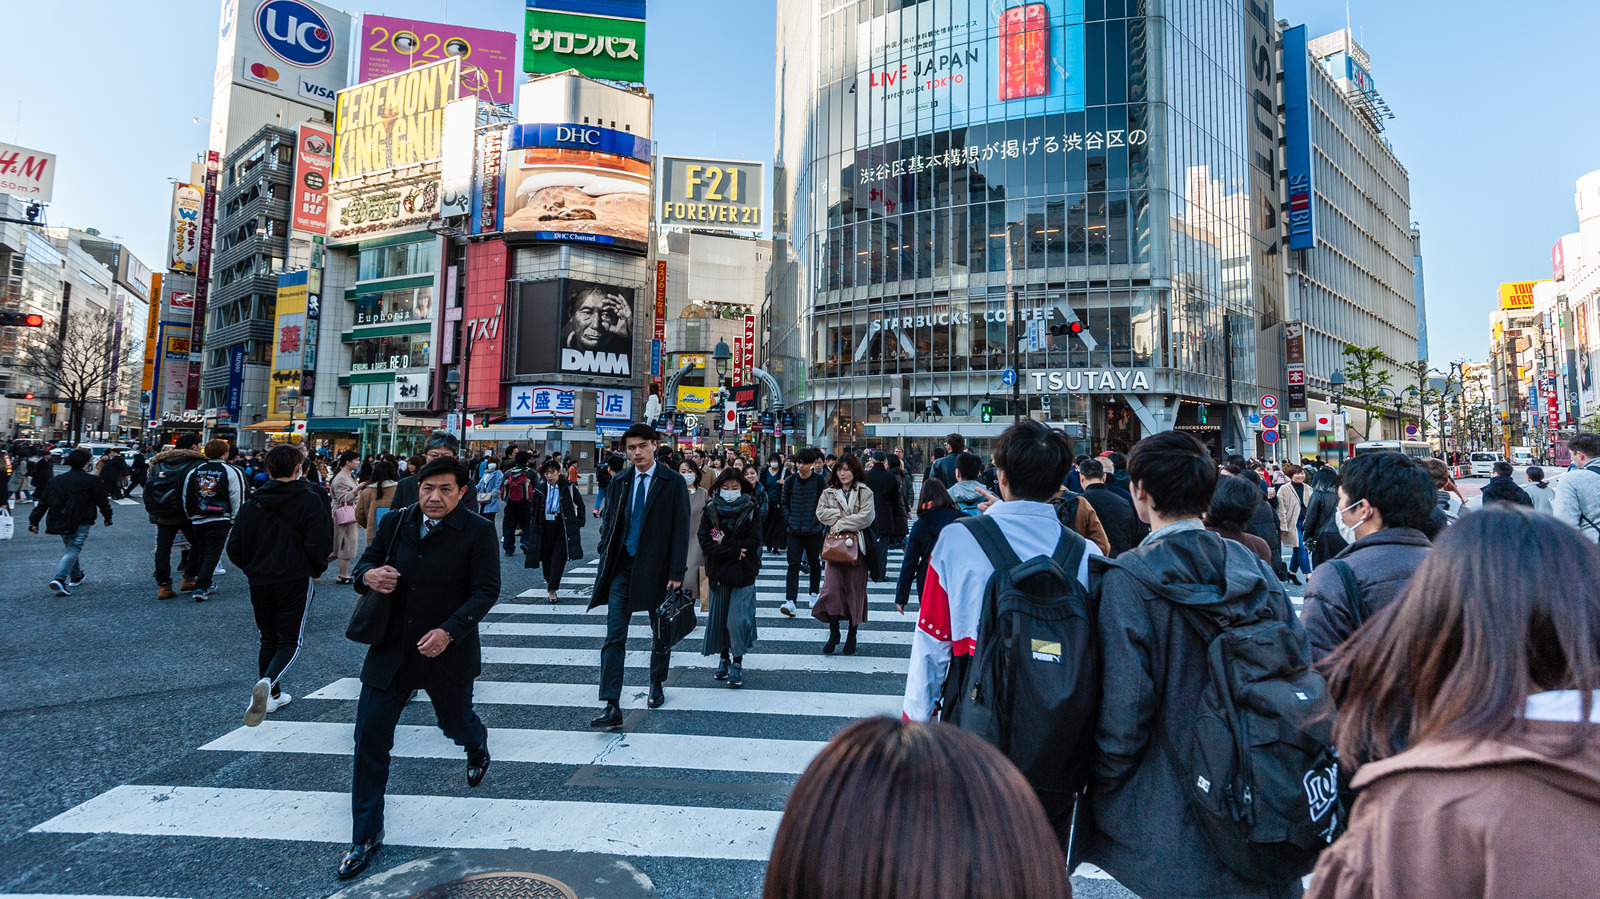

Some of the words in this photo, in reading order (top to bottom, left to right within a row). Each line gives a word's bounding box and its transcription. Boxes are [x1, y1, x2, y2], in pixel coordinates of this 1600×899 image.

[265, 8, 327, 54] UC
[369, 27, 471, 60] 2020
[529, 29, 638, 61] サロンパス
[871, 64, 907, 87] LIVE
[913, 48, 978, 77] JAPAN
[302, 81, 335, 101] VISA
[926, 74, 963, 90] TOKYO
[337, 60, 456, 135] CEREMONY
[333, 122, 387, 179] KING
[391, 107, 444, 167] GNU
[555, 127, 600, 145] DHC
[0, 150, 48, 182] H&M
[859, 128, 1148, 185] 渋谷区基本構想が掲げる渋谷区の
[304, 191, 323, 203] B1F
[686, 164, 738, 202] F21
[302, 202, 323, 215] B2F
[664, 201, 738, 223] FOREVER
[742, 206, 758, 224] 21
[1289, 173, 1310, 237] SEIBU
[554, 232, 569, 240] DHC
[569, 233, 596, 242] Channel
[657, 262, 665, 315] クスリのことなら
[358, 310, 410, 325] Euphoria
[872, 311, 971, 332] STARBUCKS
[172, 338, 190, 352] 薬
[280, 325, 300, 353] 薬
[745, 320, 754, 361] カラオケ
[561, 347, 630, 375] DMM
[1031, 370, 1150, 391] TSUTAYA
[1290, 371, 1302, 382] 本
[516, 390, 624, 413] 大盛堂店
